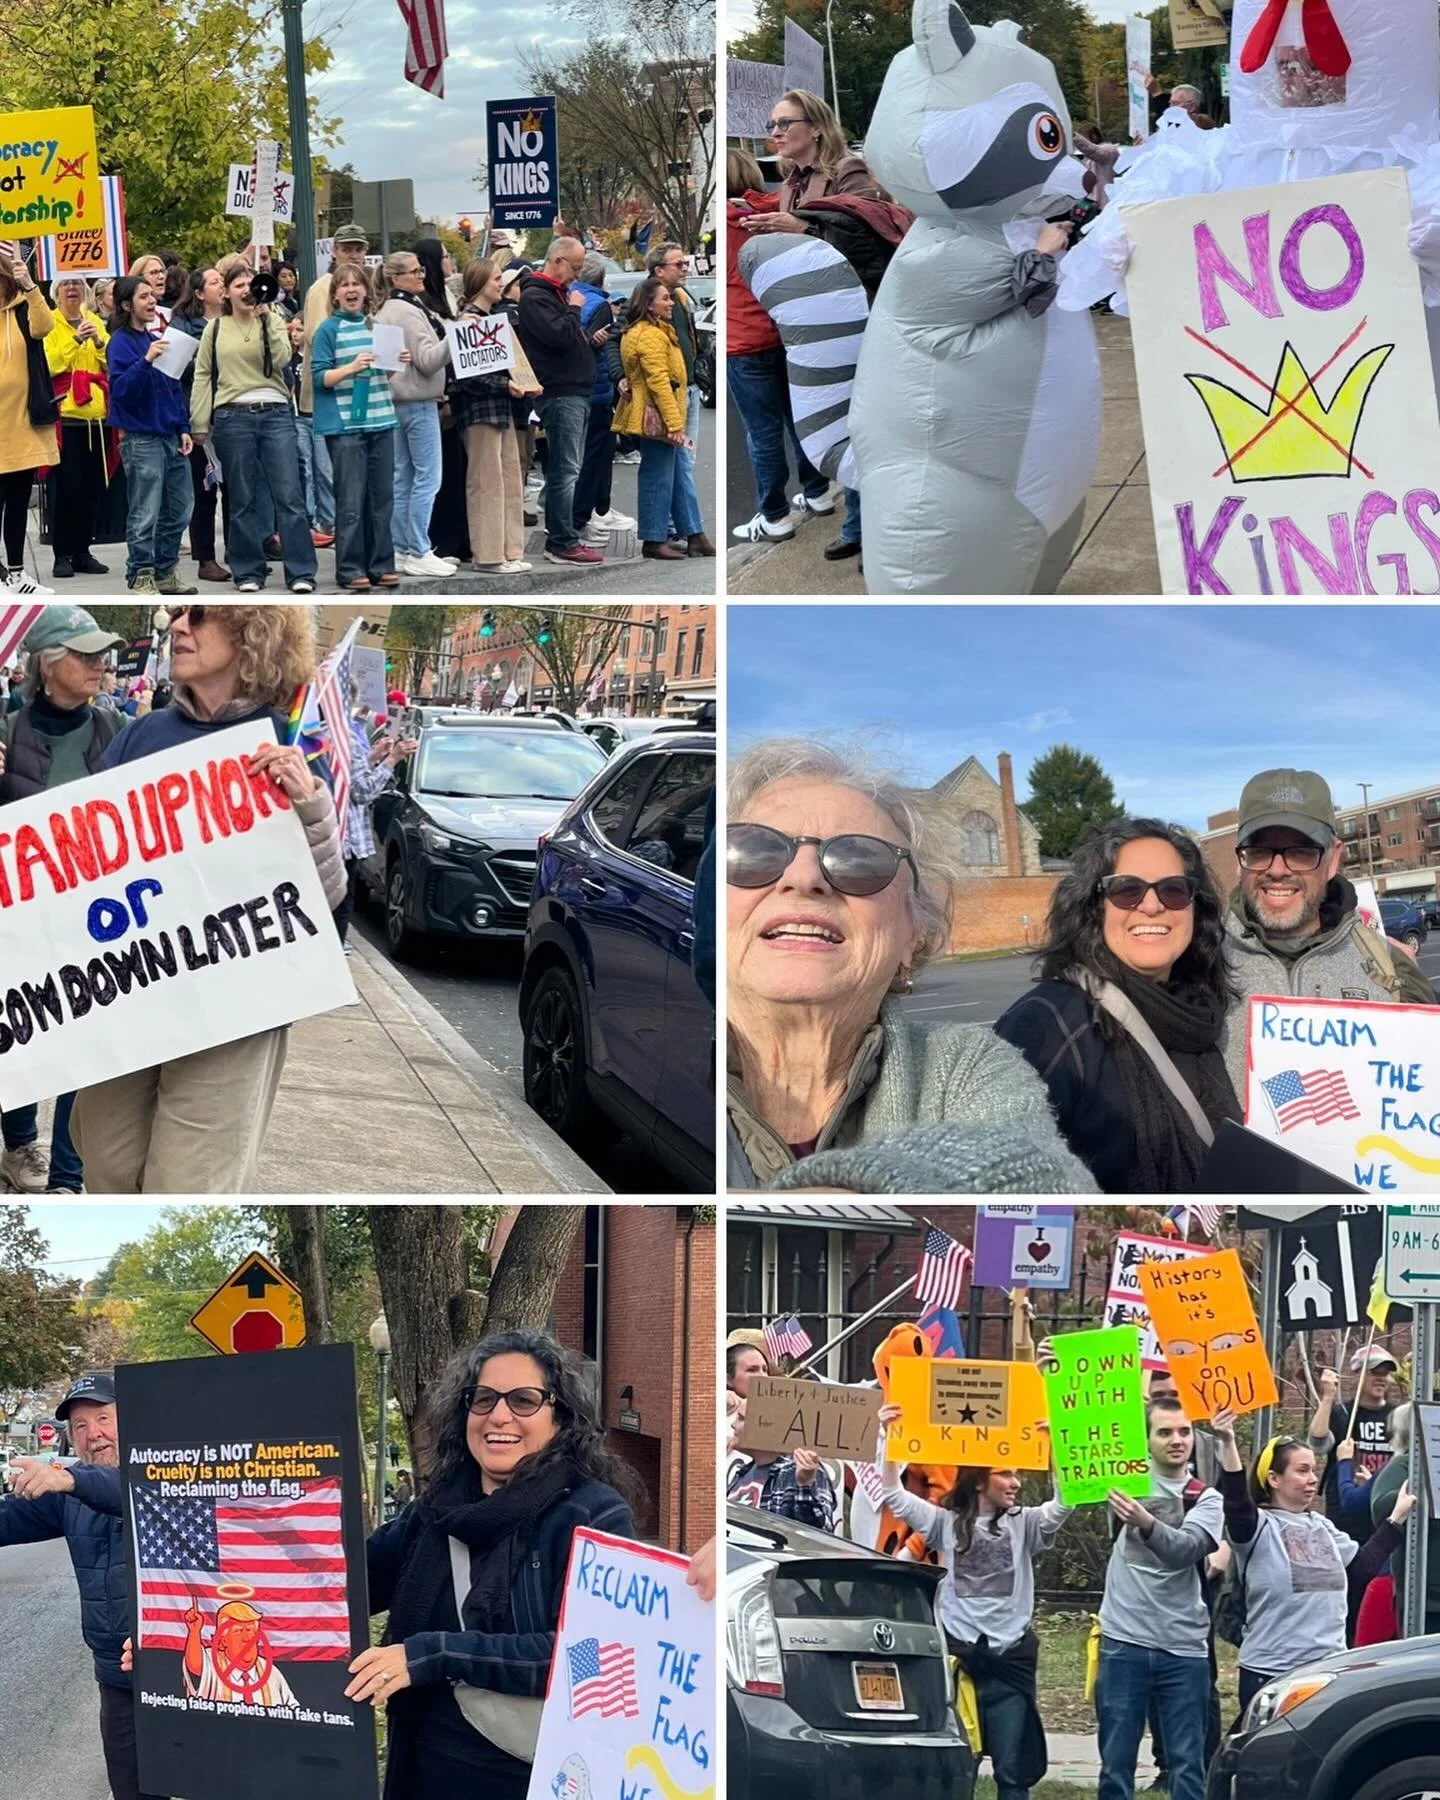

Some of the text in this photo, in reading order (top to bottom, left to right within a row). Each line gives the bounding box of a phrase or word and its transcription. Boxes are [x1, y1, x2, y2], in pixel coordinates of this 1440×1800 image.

[497, 121, 543, 158] NO
[0, 140, 58, 176] cracy
[494, 161, 549, 195] KINGS
[505, 211, 542, 220] SINCE 1776
[60, 242, 103, 262] 1776
[1193, 204, 1365, 333] NO
[455, 325, 478, 350] NO
[460, 345, 508, 369] DICTATORS
[128, 773, 188, 862] UP
[87, 878, 163, 943] or
[59, 931, 178, 1019] DOWN
[177, 881, 319, 970] LATER
[1262, 1002, 1377, 1046] RECLAIM
[1368, 1061, 1424, 1092] THE
[1354, 1163, 1397, 1190] WE
[1035, 1227, 1045, 1241] I
[1014, 1263, 1061, 1277] empathy
[1150, 1268, 1221, 1289] History
[1178, 1291, 1208, 1303] has
[1188, 1304, 1215, 1321] it's
[1050, 1353, 1134, 1374] DOWN
[1200, 1366, 1226, 1380] on
[757, 1381, 804, 1405] Liberty
[823, 1388, 867, 1406] Justice
[1070, 1373, 1104, 1390] UP
[1192, 1372, 1254, 1411] YOU
[1062, 1387, 1125, 1410] WITH
[783, 1408, 871, 1452] ALL!
[1060, 1423, 1120, 1444] THE
[129, 1442, 339, 1465] Autocracy is NOT American.
[1069, 1441, 1124, 1461] STARS
[146, 1460, 320, 1482] Cruelty is not Christian.
[1061, 1459, 1150, 1482] TRAITORS
[161, 1479, 305, 1499] Reclaiming the flag.
[577, 1539, 670, 1620] RECLAIM
[657, 1640, 701, 1694] THE
[140, 1691, 354, 1726] Rejecting false prophets with fake tans.
[652, 1695, 709, 1770] FLAG
